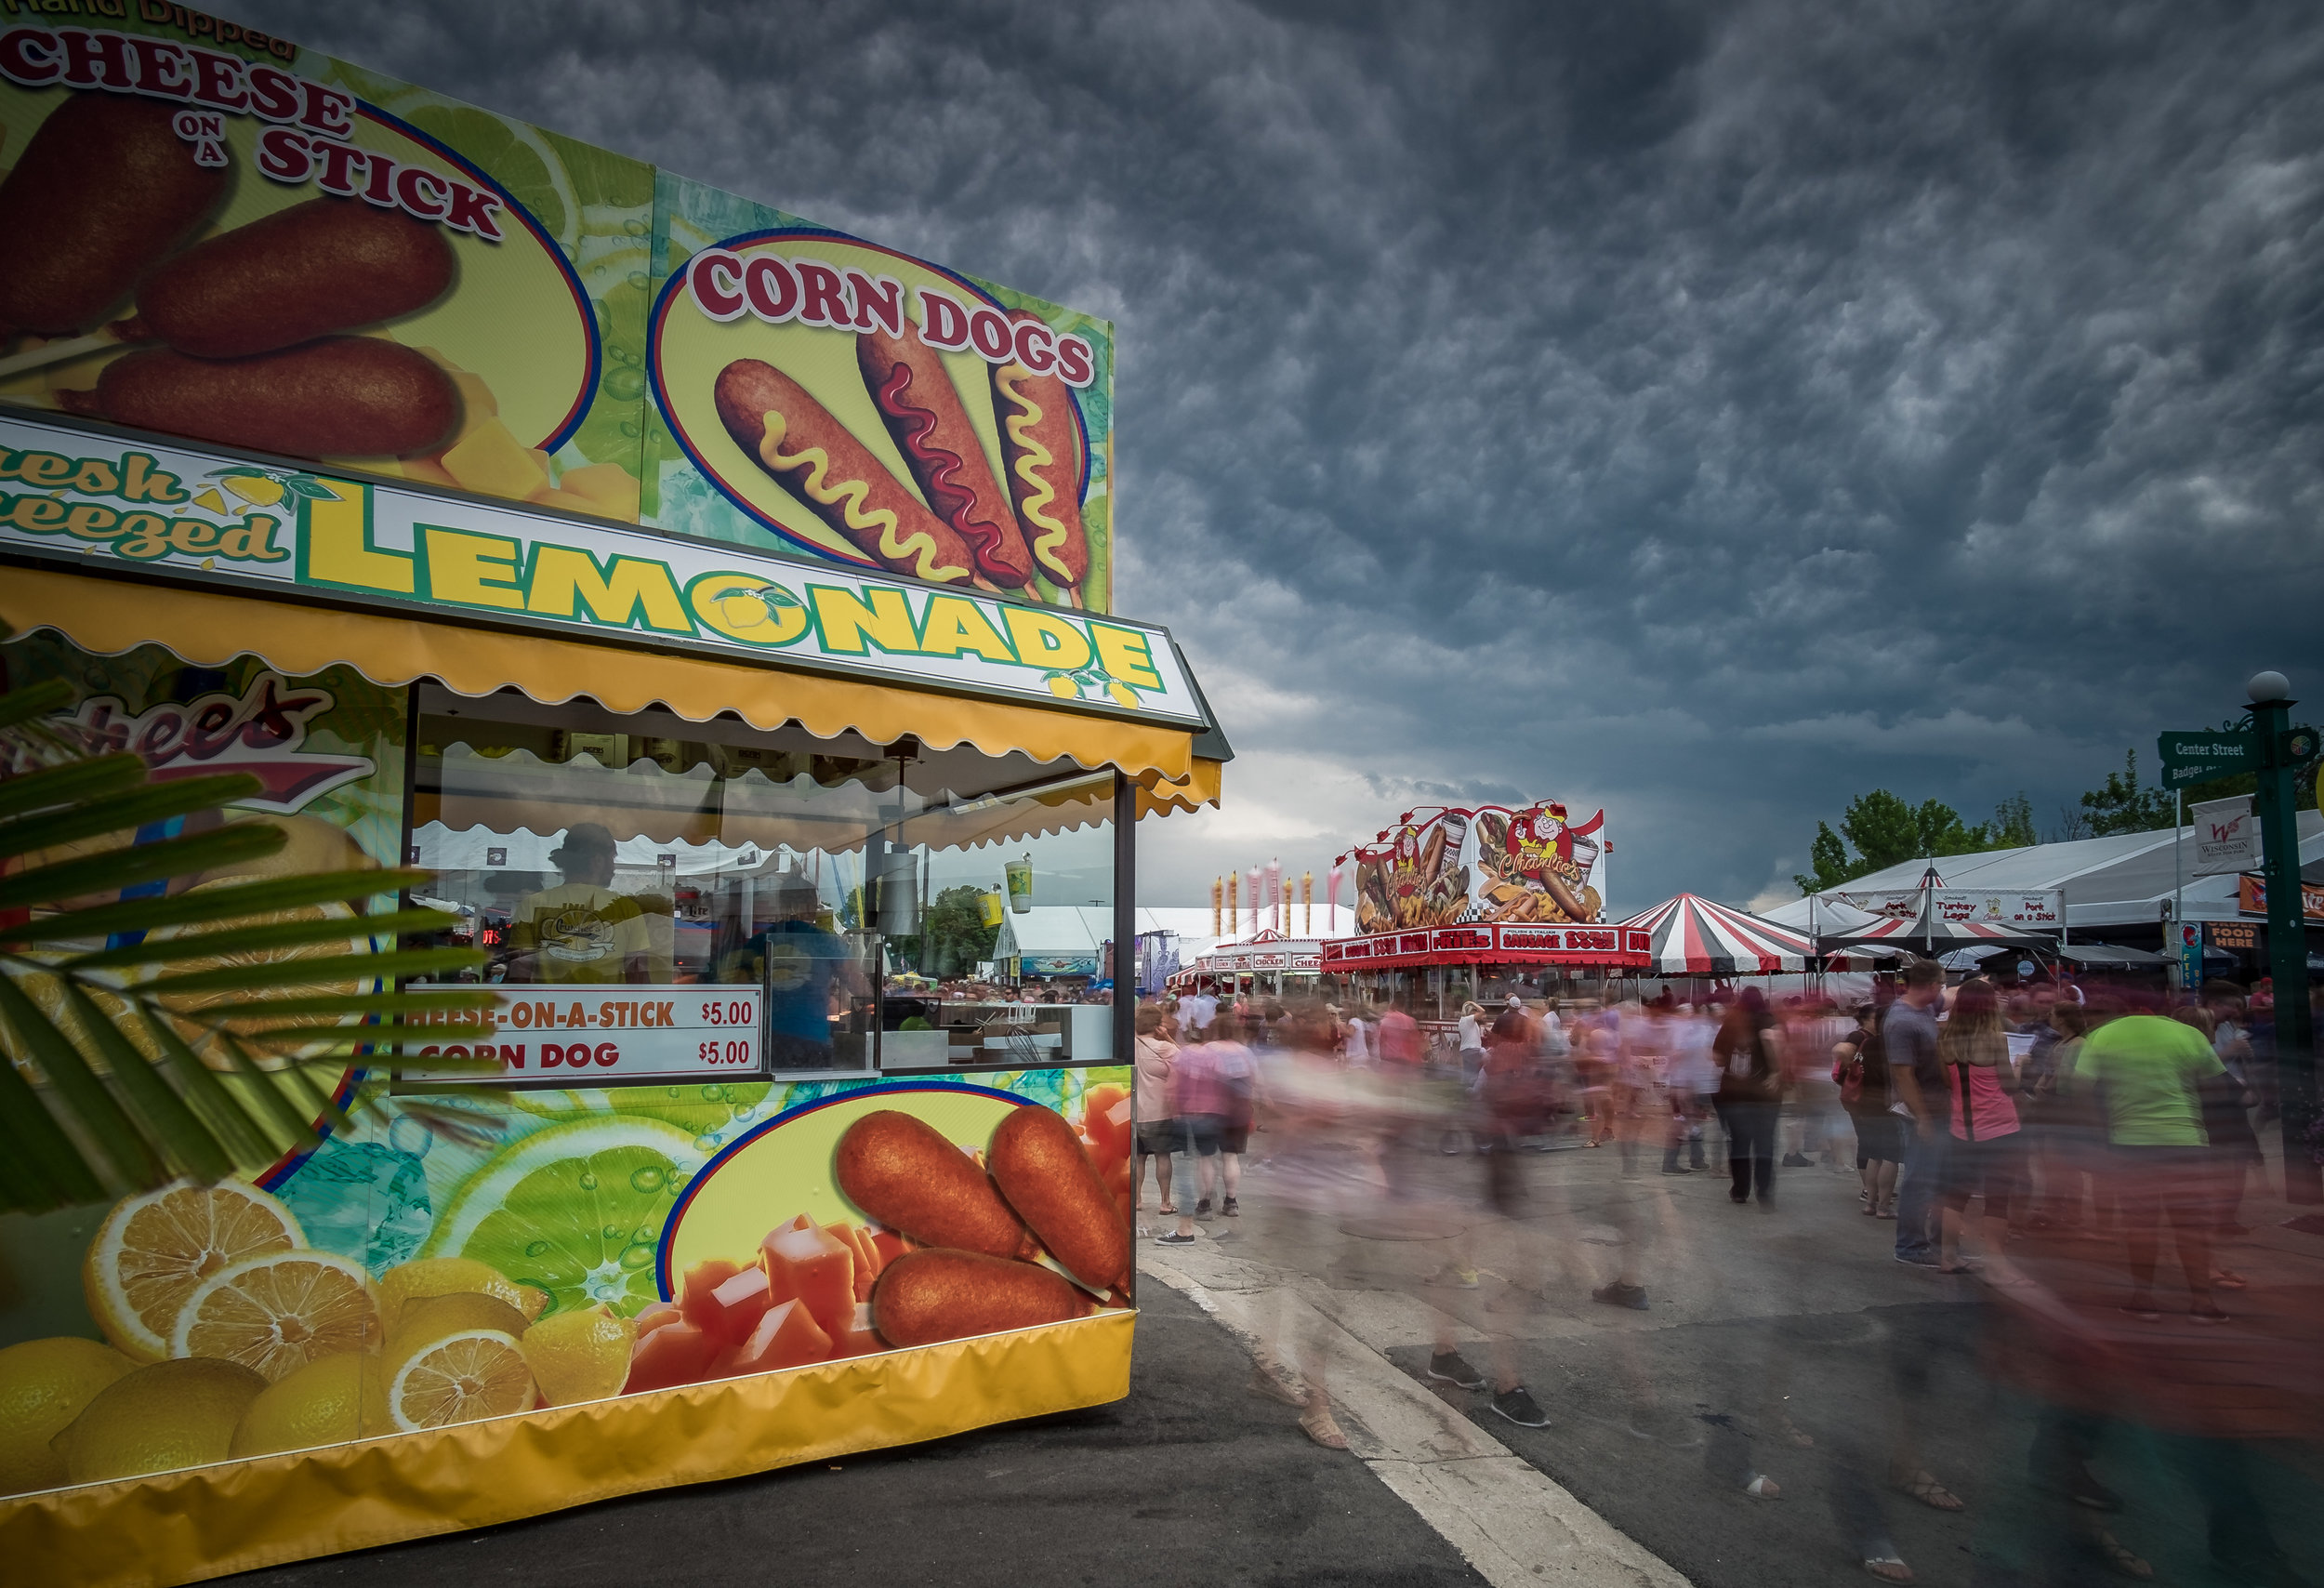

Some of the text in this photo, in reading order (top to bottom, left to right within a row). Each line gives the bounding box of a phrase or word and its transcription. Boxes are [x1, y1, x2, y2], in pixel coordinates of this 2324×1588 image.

[0, 27, 354, 137] CHEESE
[176, 112, 223, 139] ON
[198, 139, 225, 164] A
[257, 129, 503, 240] STICK
[689, 251, 1093, 386] CORN DOGS
[0, 495, 287, 560] eezed
[301, 478, 1163, 691] LEMONADE
[2175, 742, 2245, 756] Center Street
[2201, 840, 2248, 854] WISCONSIN
[1499, 852, 1581, 881] Charlie's
[1935, 902, 1977, 913] Turkey
[2025, 902, 2044, 911] Pork
[2302, 892, 2324, 909] ite
[1943, 910, 1971, 921] Legs
[2036, 912, 2056, 921] Stick
[1503, 933, 1560, 948] SAUSAGE
[1565, 931, 1615, 940] CORN
[2212, 928, 2254, 937] FOOD
[1433, 935, 1491, 949] FRIES
[2215, 937, 2253, 947] HERE
[702, 1000, 753, 1026] $5.00
[540, 1042, 620, 1069] DOG
[698, 1040, 749, 1065] $5.00
